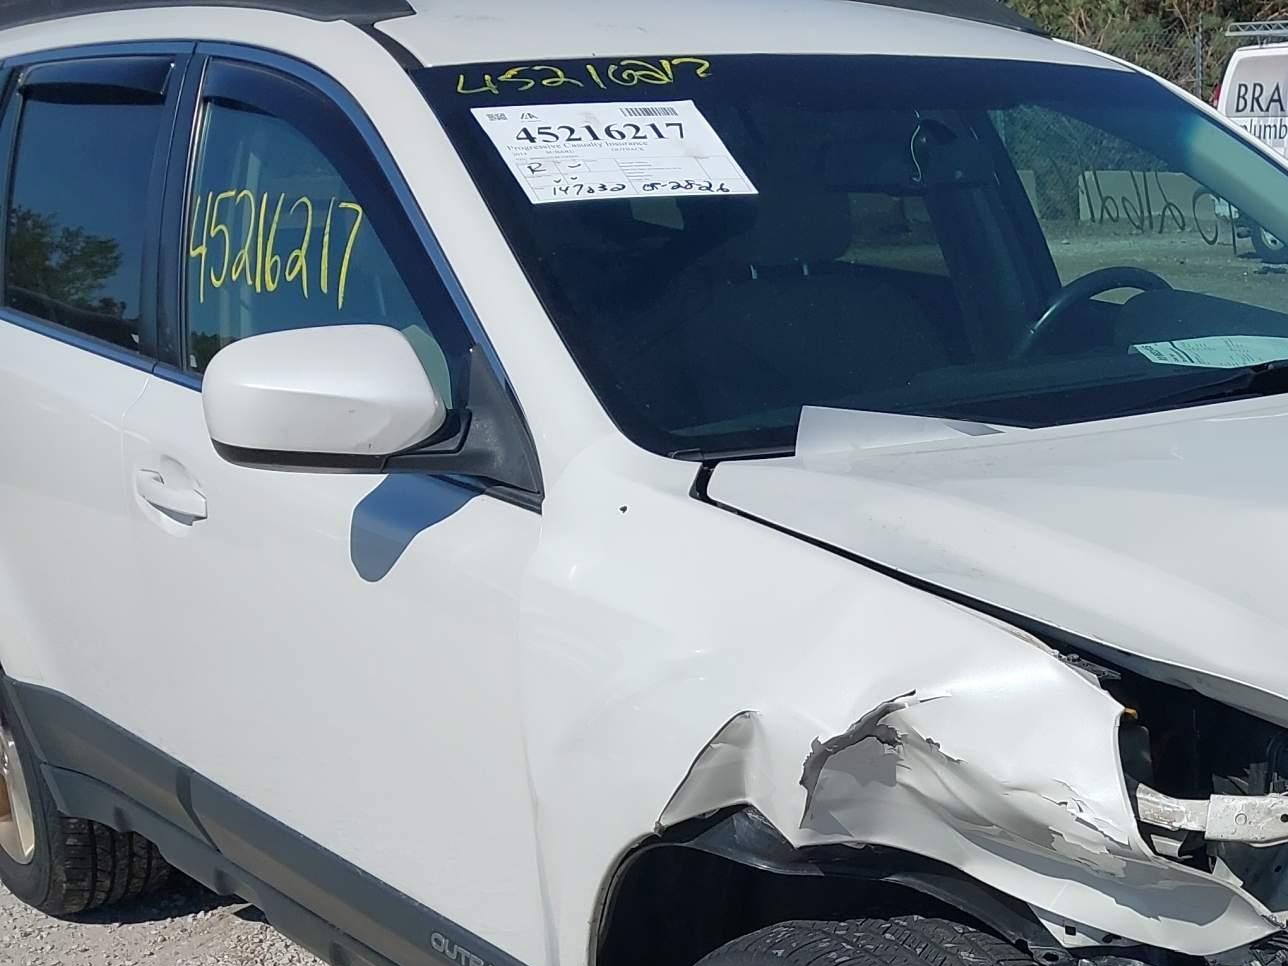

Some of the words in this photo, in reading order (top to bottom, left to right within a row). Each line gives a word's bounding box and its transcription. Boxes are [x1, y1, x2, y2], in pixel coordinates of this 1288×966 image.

[515, 122, 686, 144] 45216217
[505, 142, 561, 152] Progressive
[562, 140, 602, 149] Casualty
[604, 139, 649, 148] Insurance
[189, 188, 363, 311] 45216217
